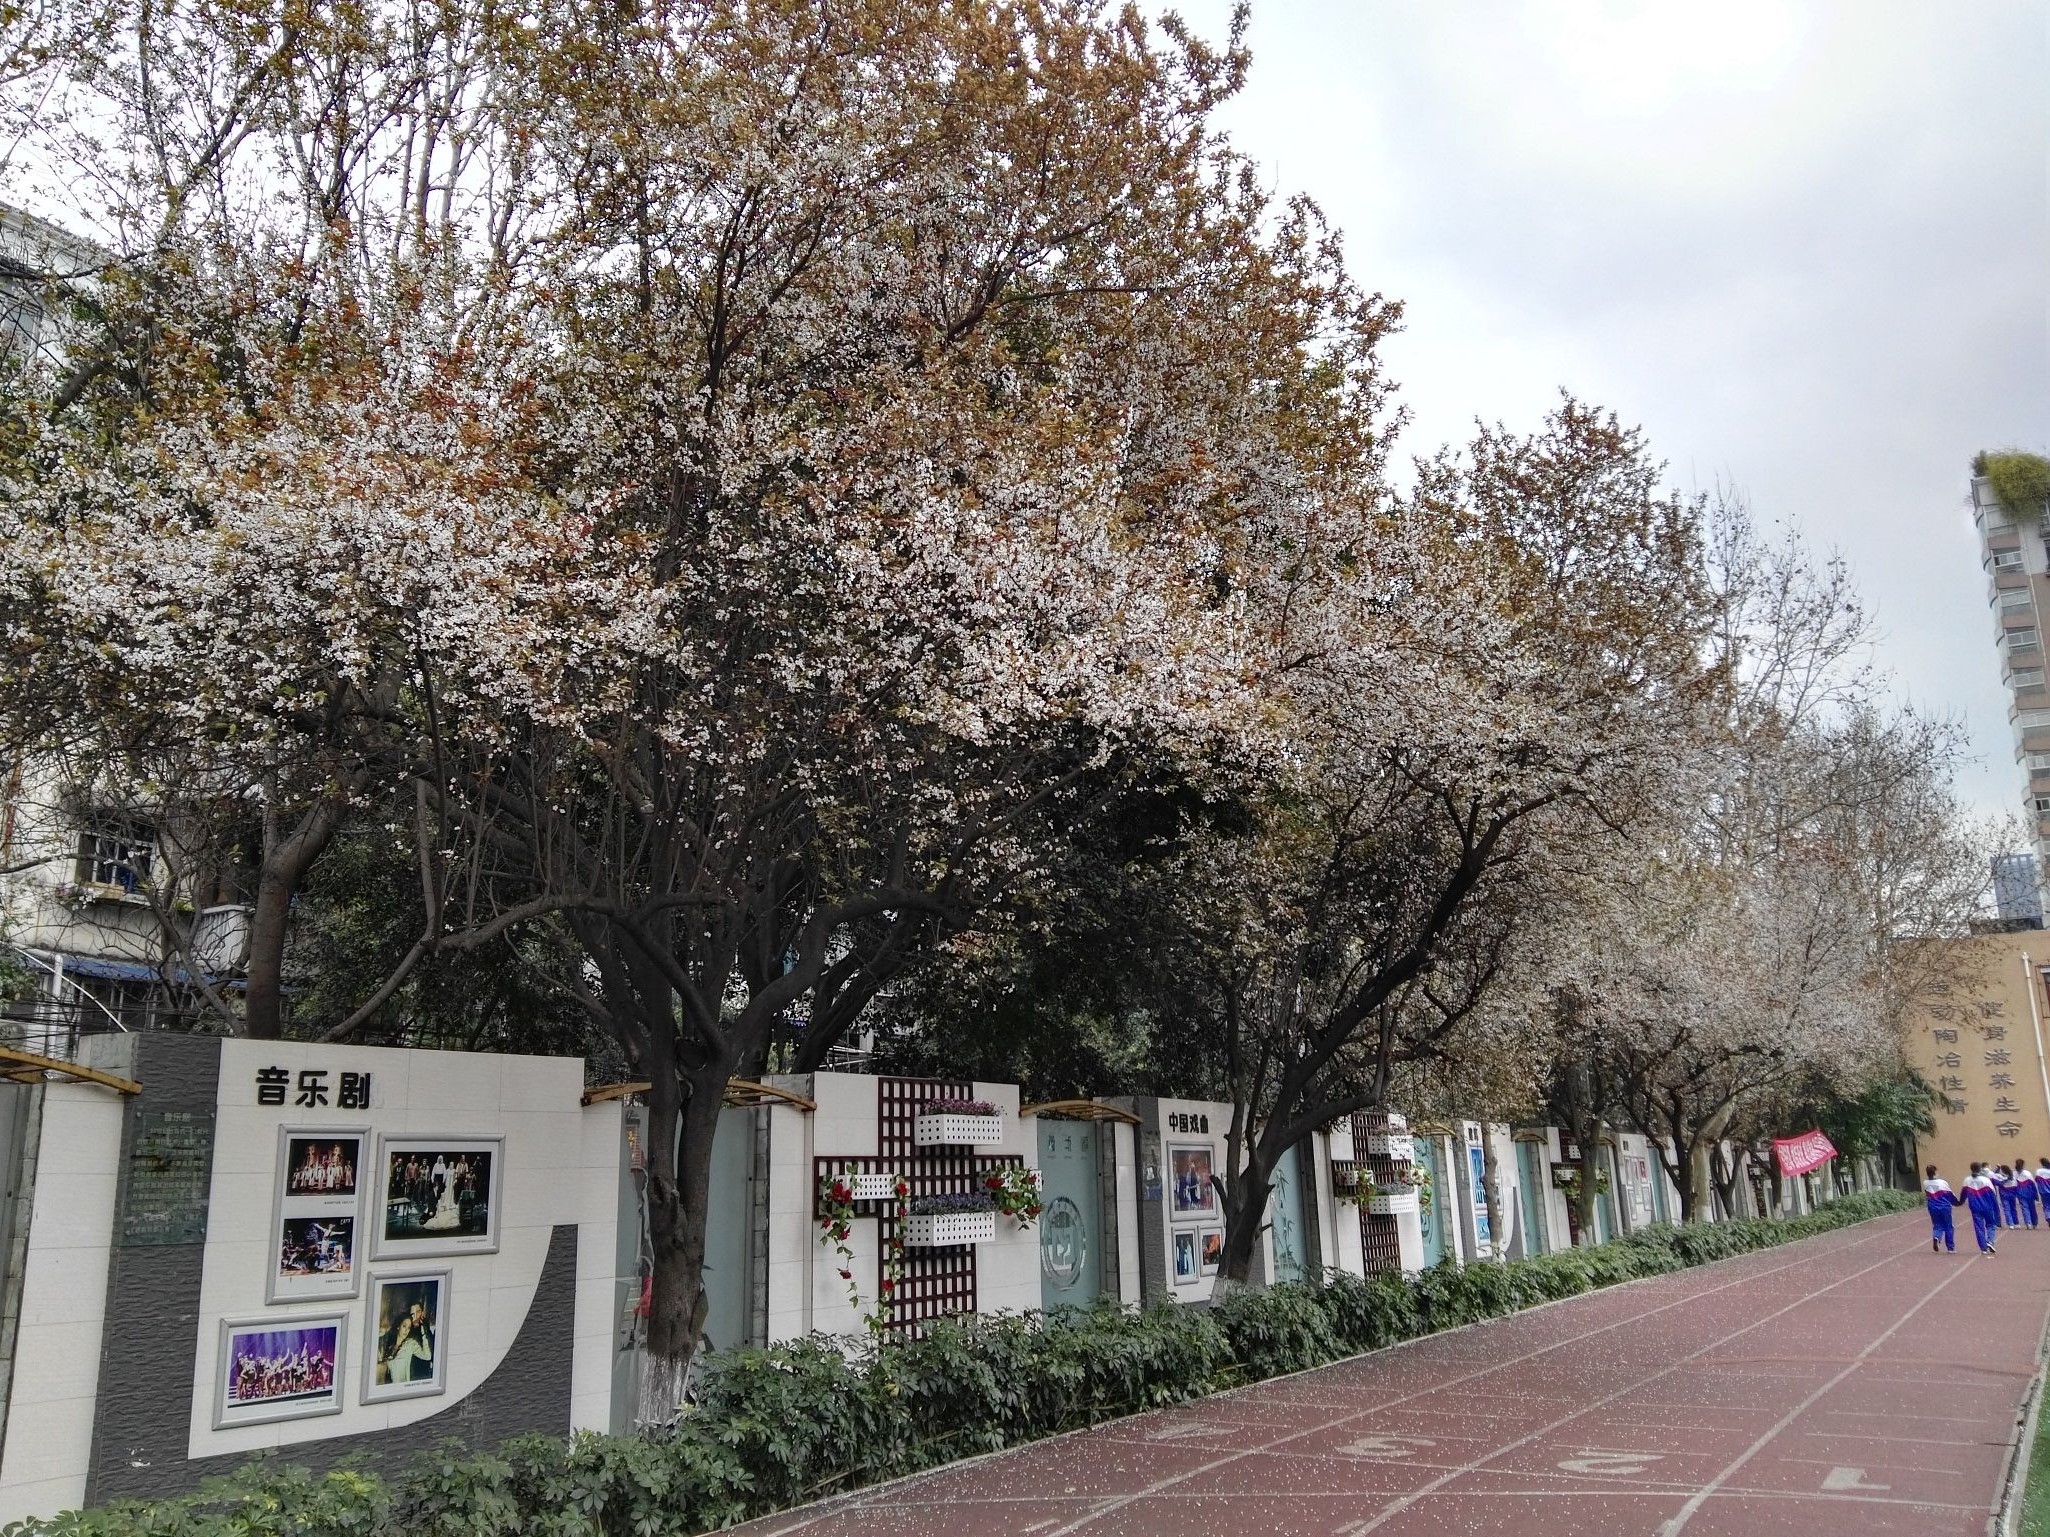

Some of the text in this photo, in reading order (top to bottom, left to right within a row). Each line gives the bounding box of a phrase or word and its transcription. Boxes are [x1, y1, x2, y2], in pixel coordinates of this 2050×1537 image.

[255, 1065, 371, 1109] 音乐剧
[1168, 1111, 1209, 1134] 中国戏曲
[1557, 1450, 1665, 1474] 2
